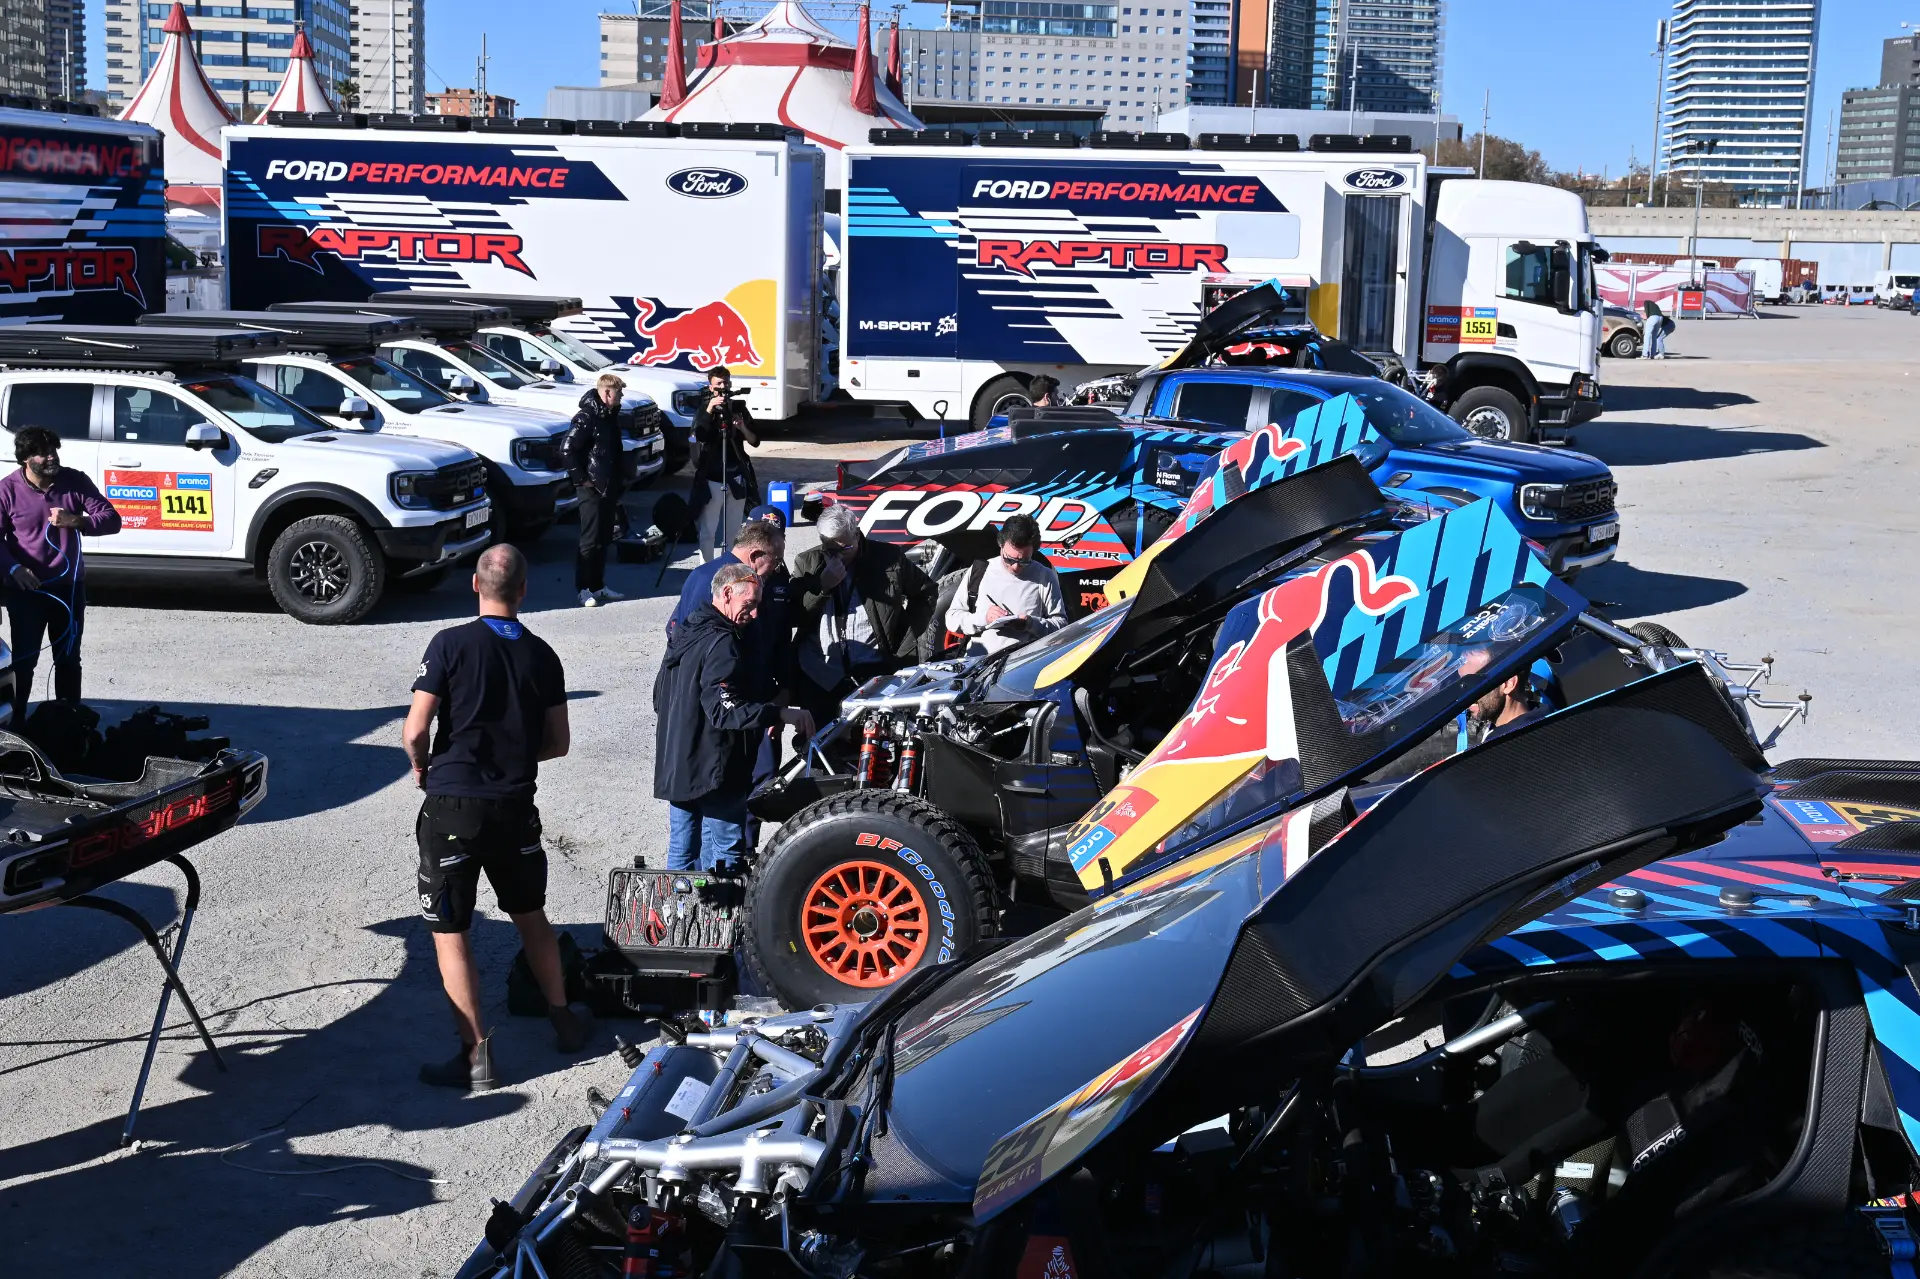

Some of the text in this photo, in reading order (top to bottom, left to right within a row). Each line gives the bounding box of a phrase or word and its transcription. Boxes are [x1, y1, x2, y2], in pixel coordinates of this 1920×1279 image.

[266, 160, 569, 189] FORD PERFORMANCE
[679, 169, 737, 197] Ford
[1354, 168, 1397, 190] Ford
[972, 180, 1257, 205] FORD PERFORMANCE
[257, 223, 537, 281] RAPTOR
[976, 239, 1229, 279] RAPTOR
[859, 320, 932, 331] M-SPORT
[1428, 316, 1459, 324] aramco
[1465, 321, 1492, 334] 1551
[178, 476, 209, 486] aramco
[109, 487, 154, 499] aramco
[164, 495, 208, 515] 1141
[857, 490, 1100, 544] FORD
[1052, 547, 1124, 562] RAPTOR
[1459, 610, 1491, 632] Cruz
[855, 832, 956, 965] BFGoodric
